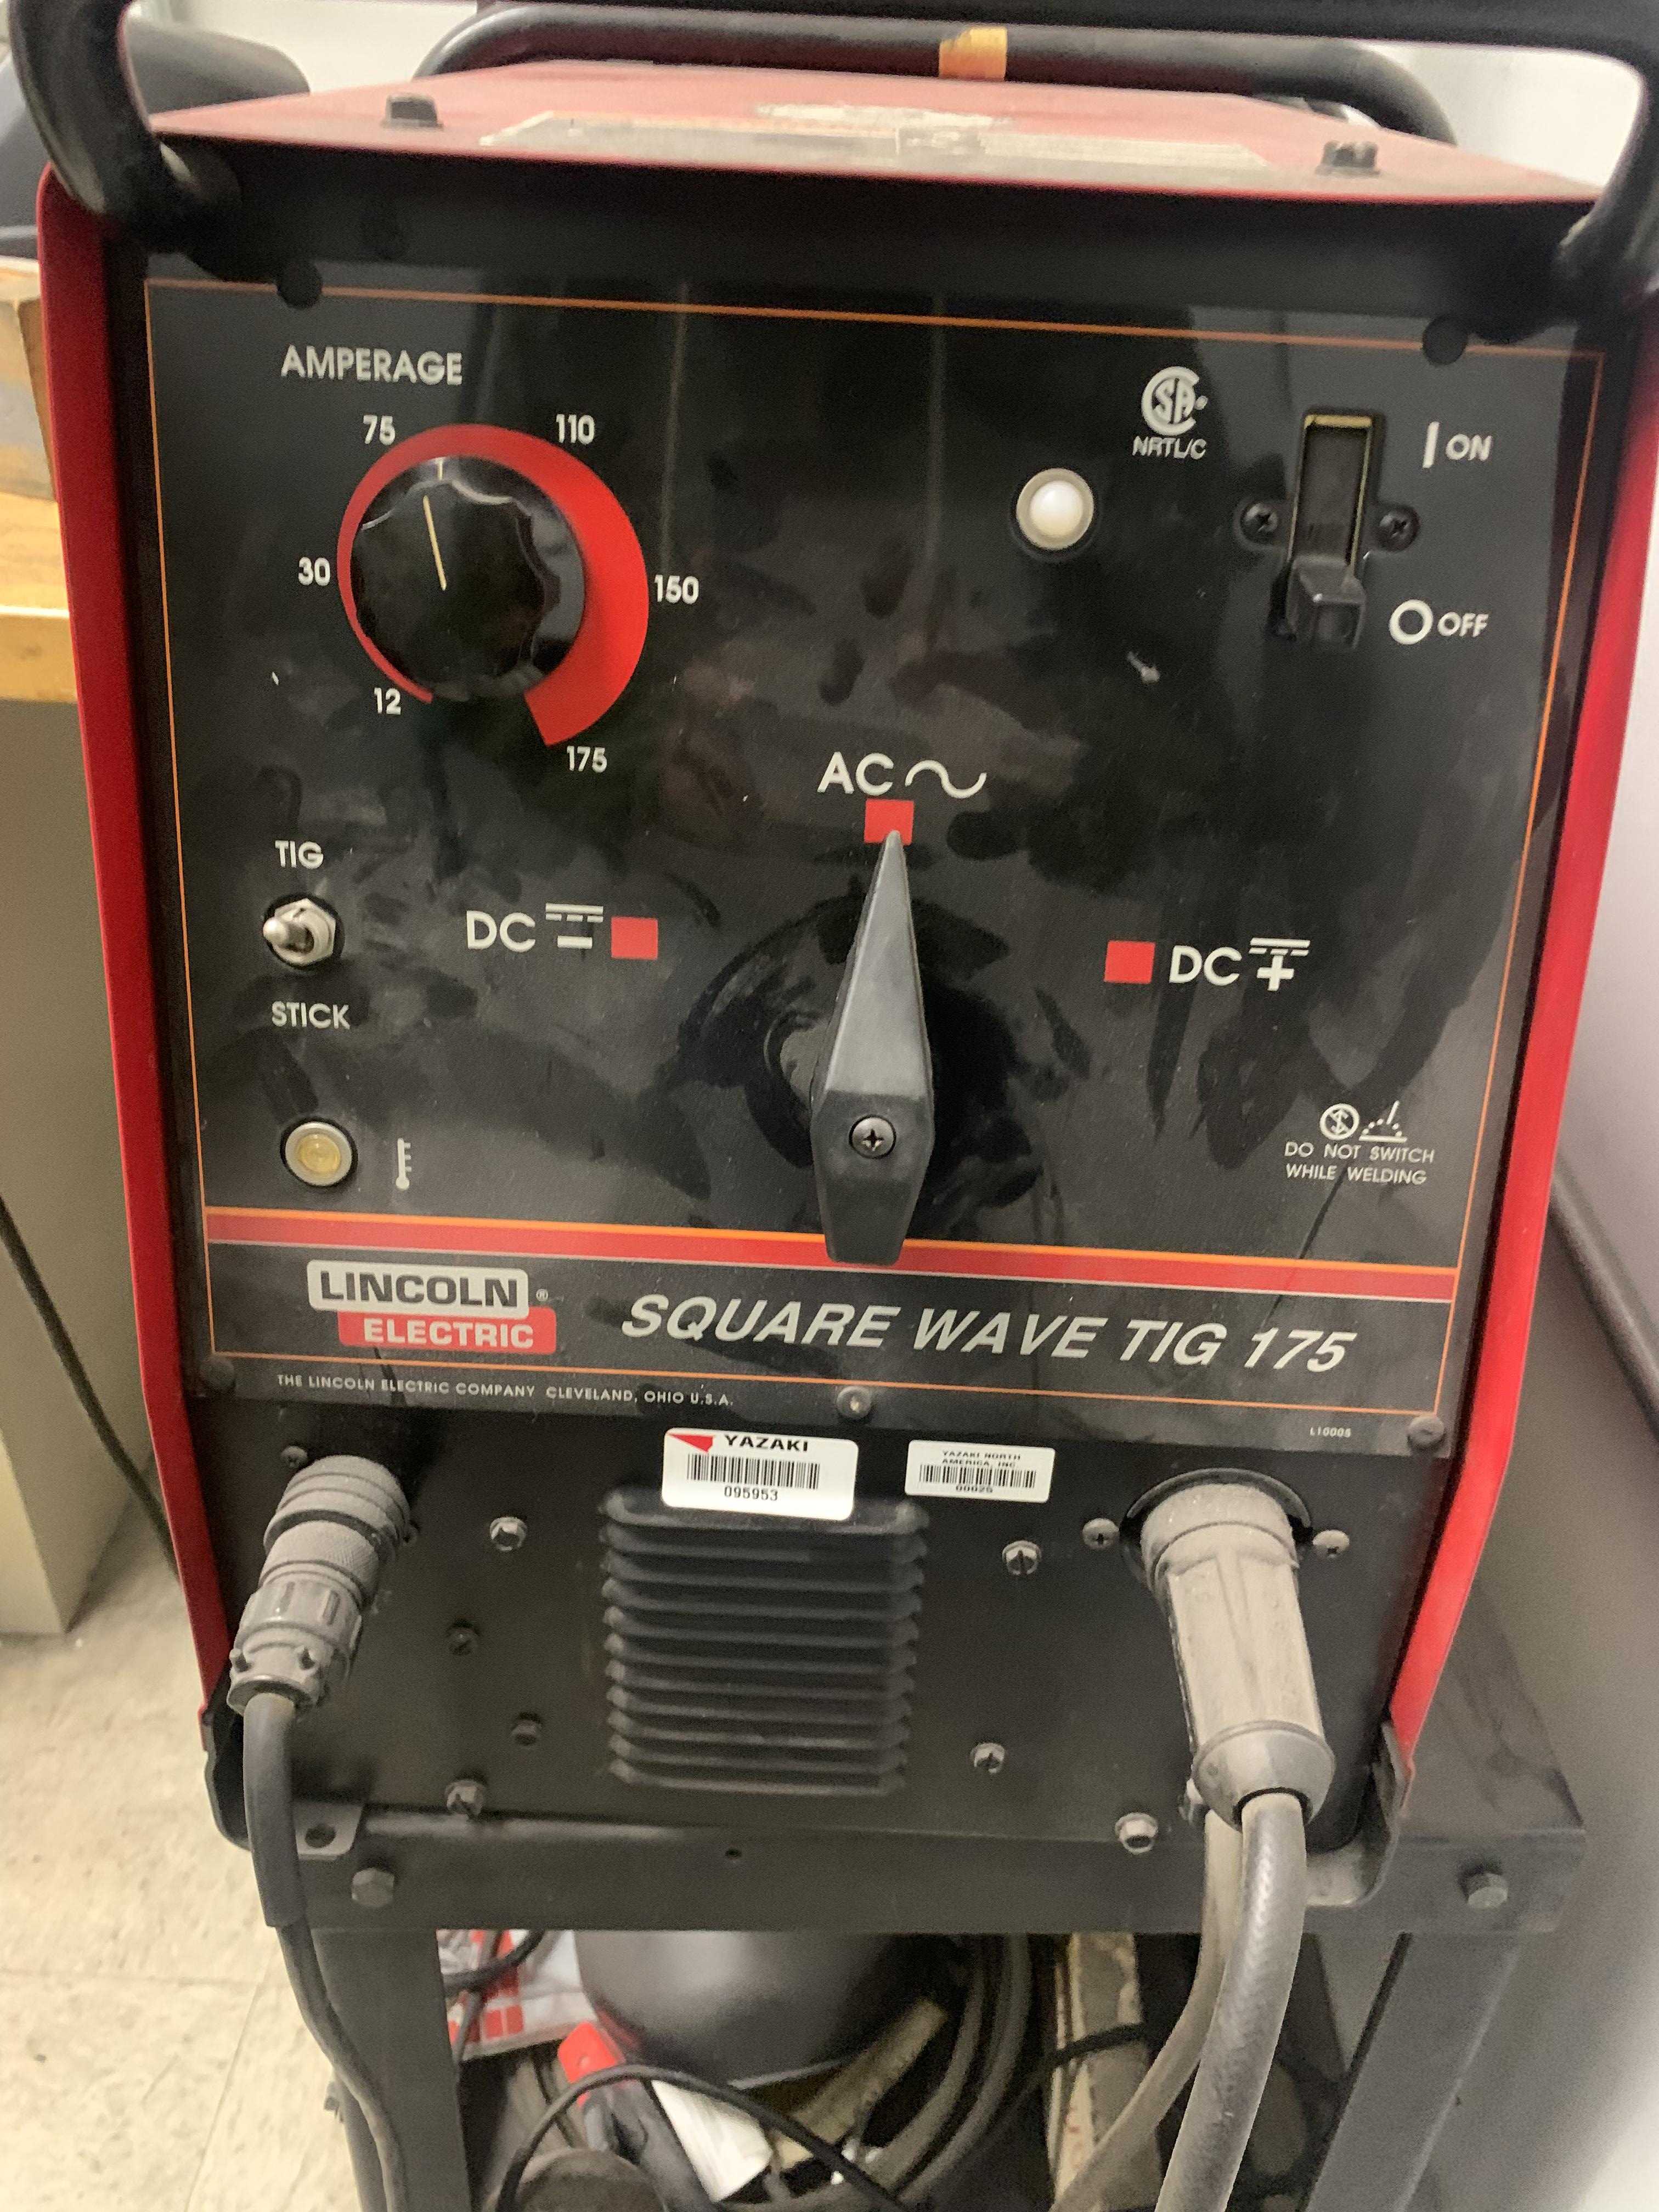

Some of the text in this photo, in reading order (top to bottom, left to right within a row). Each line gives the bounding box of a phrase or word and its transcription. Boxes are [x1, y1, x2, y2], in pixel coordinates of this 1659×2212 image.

[281, 345, 462, 385] AMPERAGE
[363, 415, 396, 445] 75
[556, 414, 595, 444] 110
[1446, 434, 1492, 460] ON
[298, 557, 331, 586] 30
[654, 574, 699, 604] 150
[1437, 612, 1488, 637] OFF
[374, 687, 401, 714] 12
[567, 746, 607, 772] 175
[817, 752, 894, 795] AC
[275, 840, 324, 869] TIG
[466, 911, 535, 952] DC
[1169, 945, 1242, 986] DC
[272, 1001, 350, 1030] STICK
[1284, 1142, 1435, 1163] DO NOT SWITCH
[1286, 1163, 1427, 1185] WHILE WELDING
[364, 1318, 533, 1348] ELECTRIC
[622, 1294, 1357, 1372] SQUARE WAVE TIG 175
[278, 1374, 302, 1387] THE
[309, 1376, 375, 1391] LINCOLN
[381, 1379, 449, 1394] ELECTRIC
[455, 1383, 535, 1397] COMPANY
[546, 1386, 637, 1403] CLEVELAND,
[644, 1391, 684, 1403] OHIO
[725, 1434, 809, 1452] YAZAKI
[724, 1485, 778, 1501] 095953
